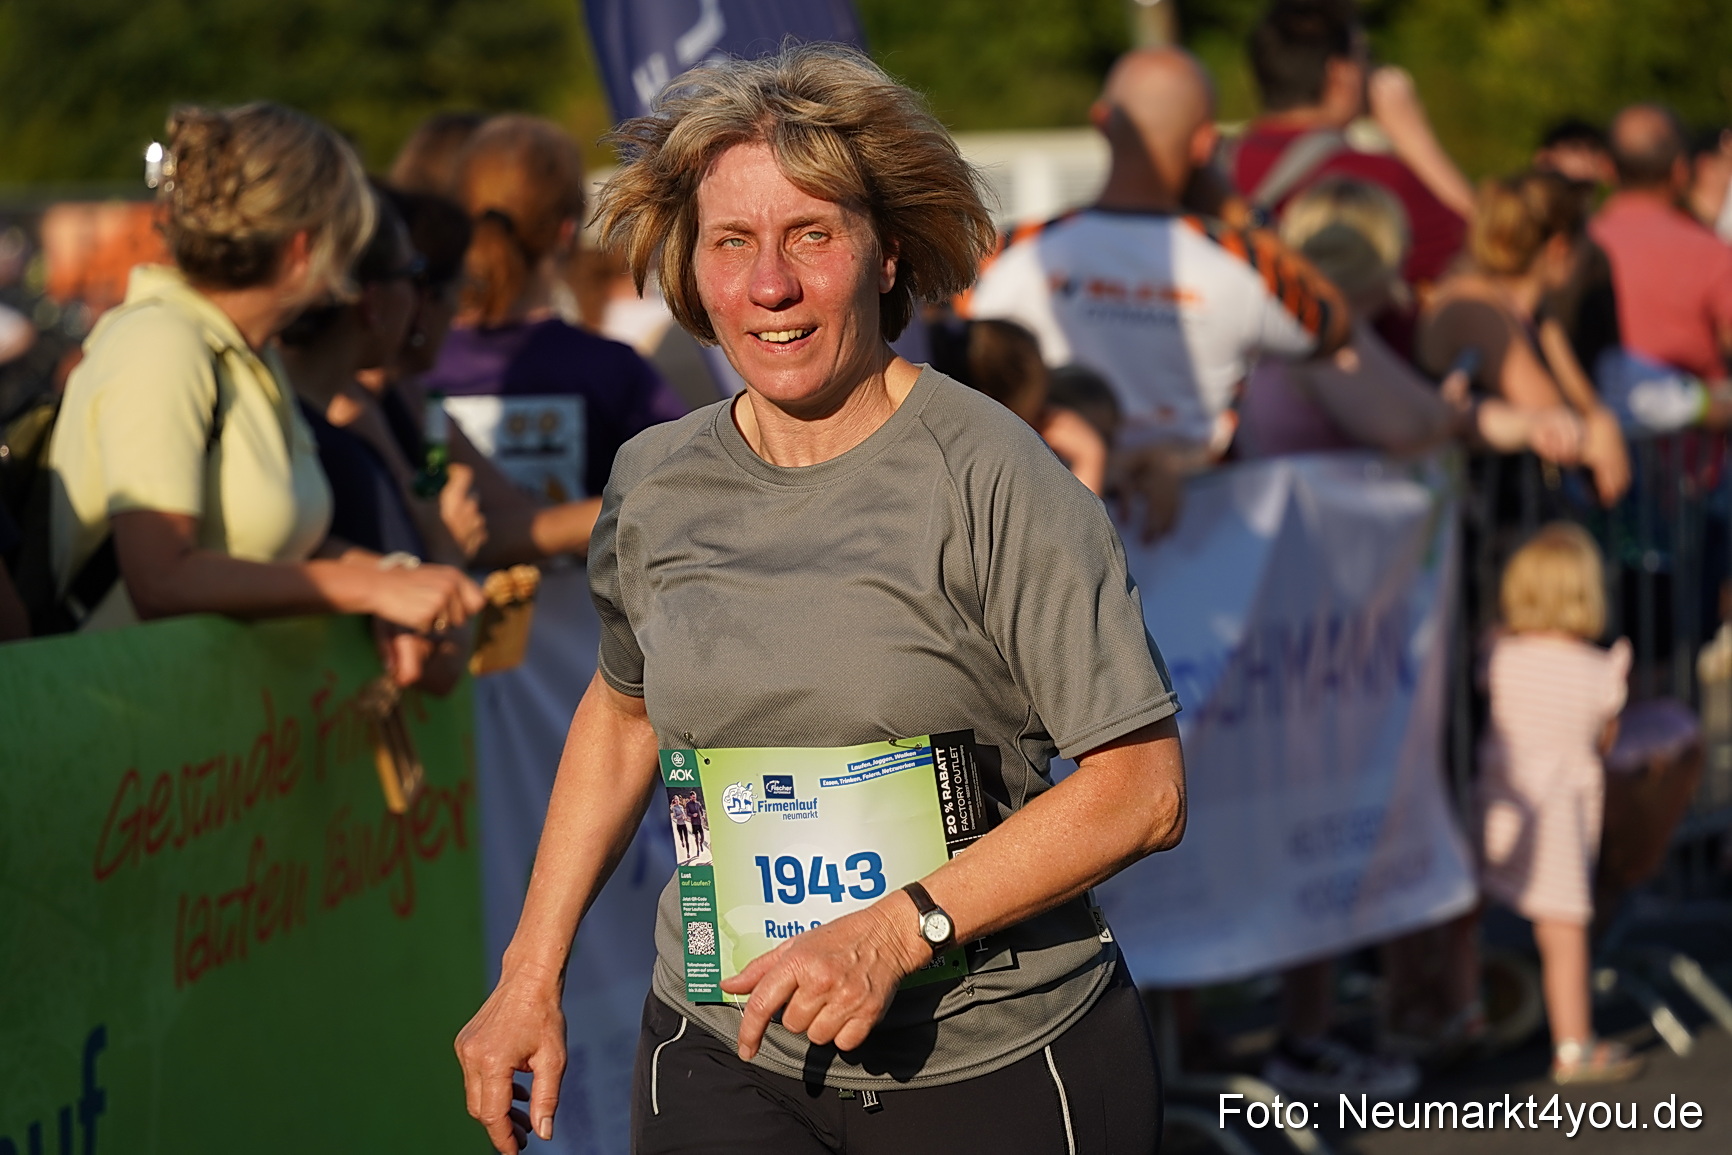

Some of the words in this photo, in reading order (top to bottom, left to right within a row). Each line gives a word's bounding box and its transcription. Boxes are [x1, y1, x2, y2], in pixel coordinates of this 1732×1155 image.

[839, 776, 862, 785] Trinken,
[862, 770, 881, 780] Feiern,
[881, 762, 915, 775] Netzwerken
[850, 762, 872, 771] Laufen,
[872, 756, 894, 766] Joggen,
[935, 747, 952, 800] RABATT
[949, 746, 962, 784] OUTLET
[668, 769, 695, 781] AOK
[757, 797, 818, 813] Firmenlauf
[944, 801, 954, 813] %
[955, 785, 969, 831] FACTORY
[782, 811, 818, 820] neumarkt
[946, 815, 958, 835] 20
[754, 851, 887, 905] 1943
[764, 919, 805, 939] Ruth
